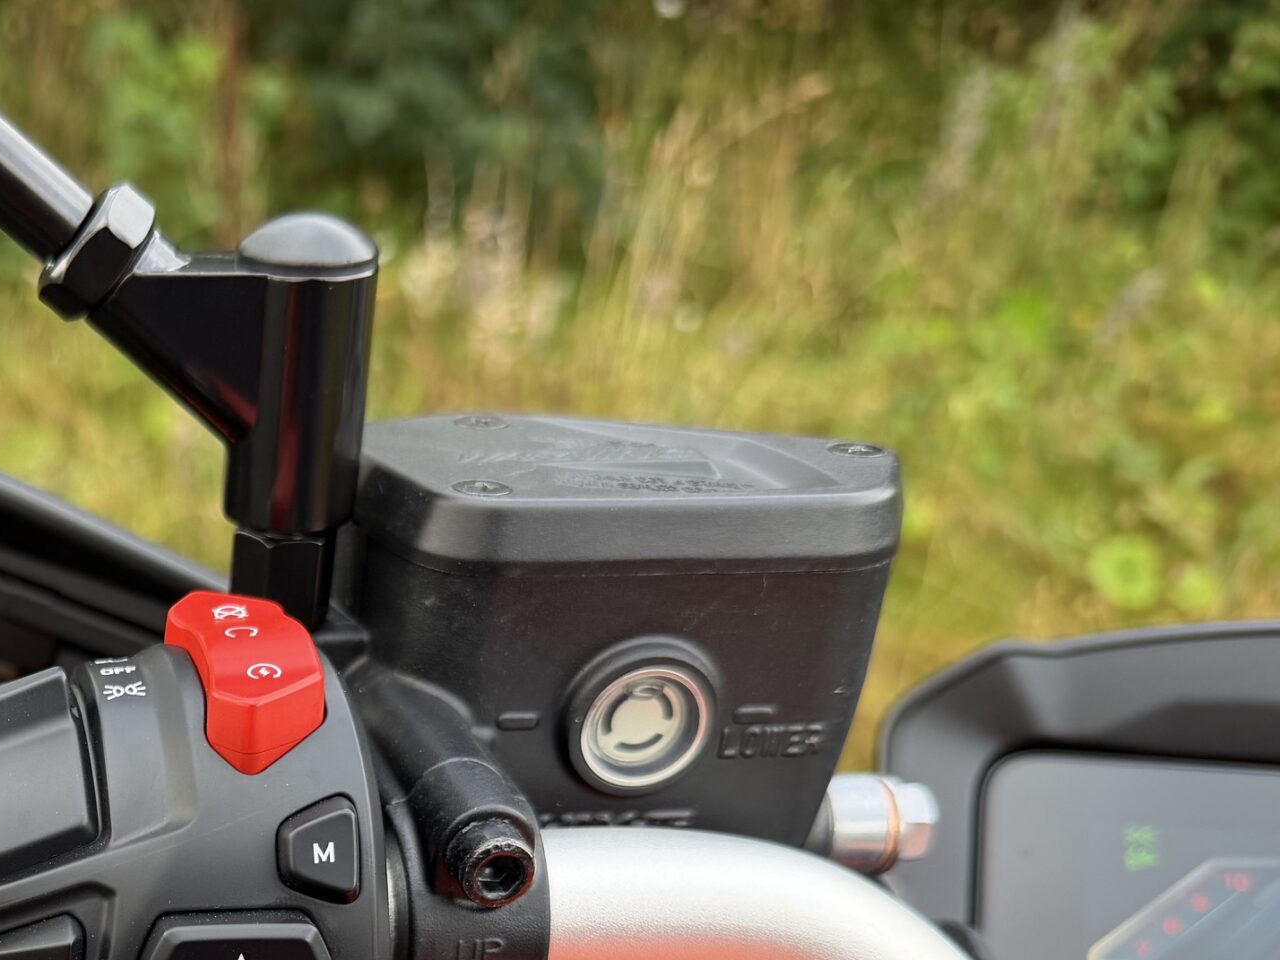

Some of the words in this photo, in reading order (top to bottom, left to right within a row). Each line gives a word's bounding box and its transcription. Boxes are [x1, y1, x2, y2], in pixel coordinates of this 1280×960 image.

[100, 665, 136, 676] OFF
[718, 724, 824, 760] LOWER
[313, 841, 335, 864] M
